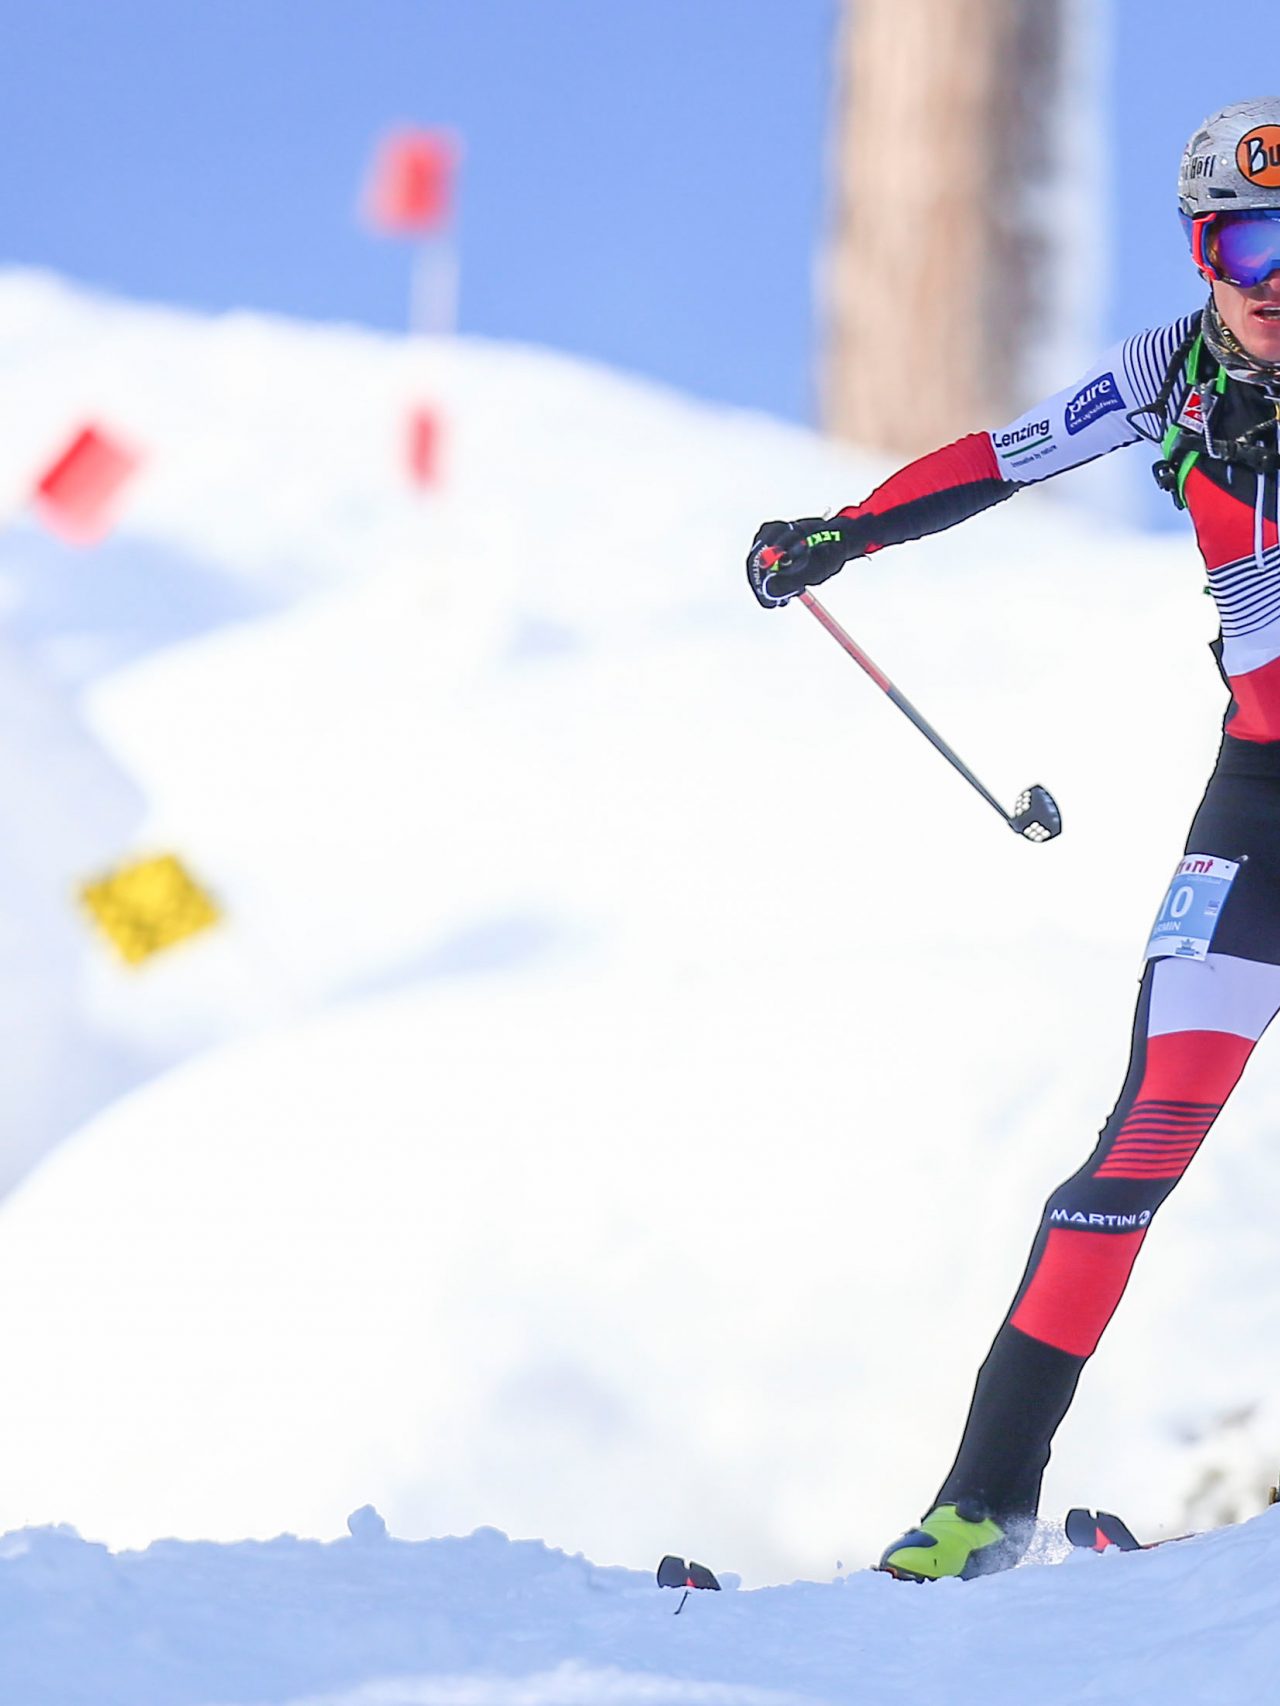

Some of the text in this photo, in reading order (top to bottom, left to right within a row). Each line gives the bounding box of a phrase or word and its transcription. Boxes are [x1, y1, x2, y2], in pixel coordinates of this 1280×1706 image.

[1067, 379, 1112, 421] pure
[991, 418, 1051, 448] Lenzing
[805, 530, 842, 548] LEKI
[1050, 1208, 1137, 1227] MARTINI
